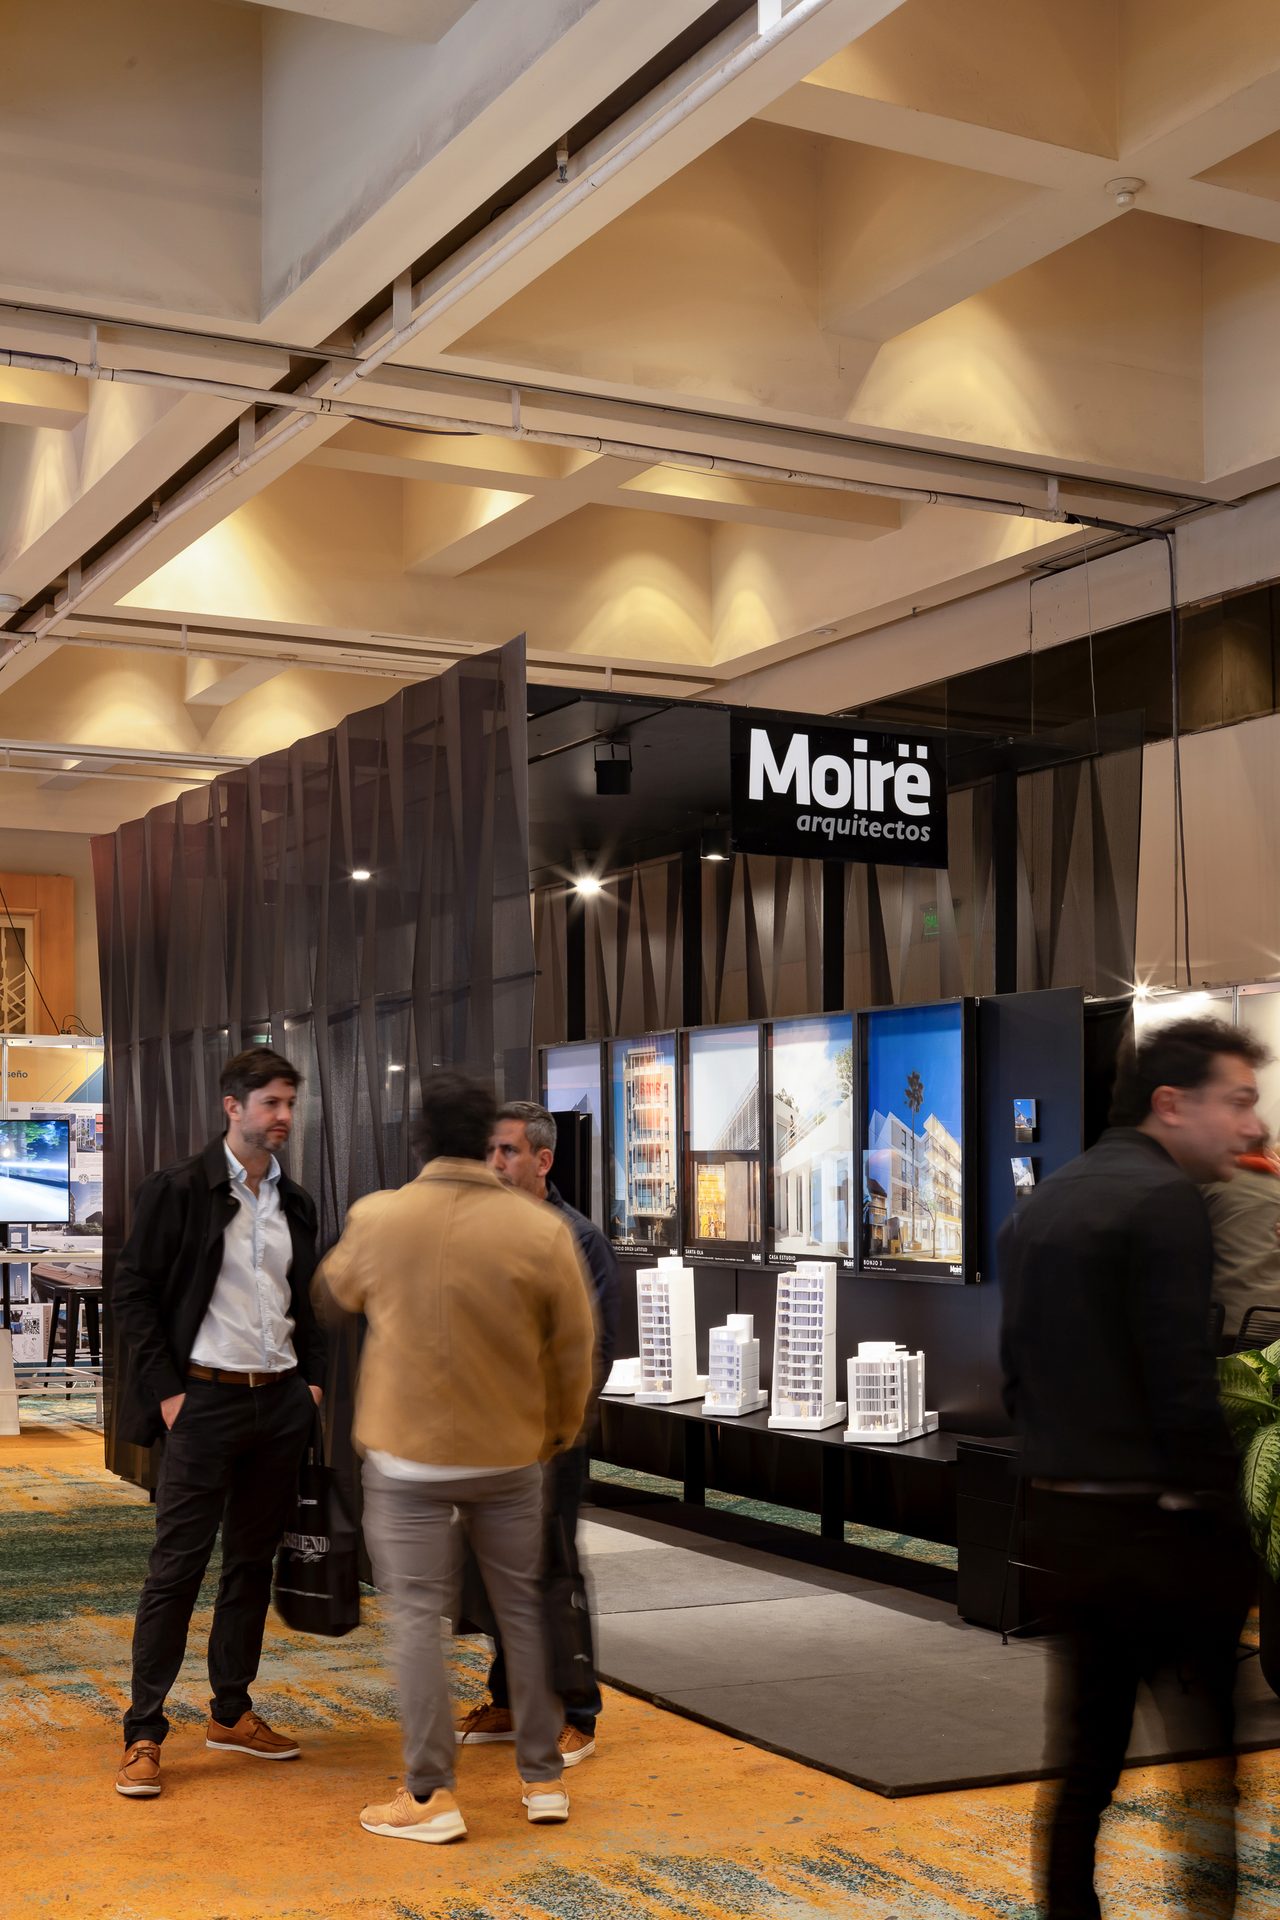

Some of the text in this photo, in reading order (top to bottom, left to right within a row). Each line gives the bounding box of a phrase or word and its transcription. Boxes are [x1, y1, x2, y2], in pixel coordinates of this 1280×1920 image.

[749, 728, 931, 816] Moirë
[796, 814, 931, 842] arquitectos
[0, 1069, 28, 1079] seño
[779, 1254, 797, 1262] ESTUDIO
